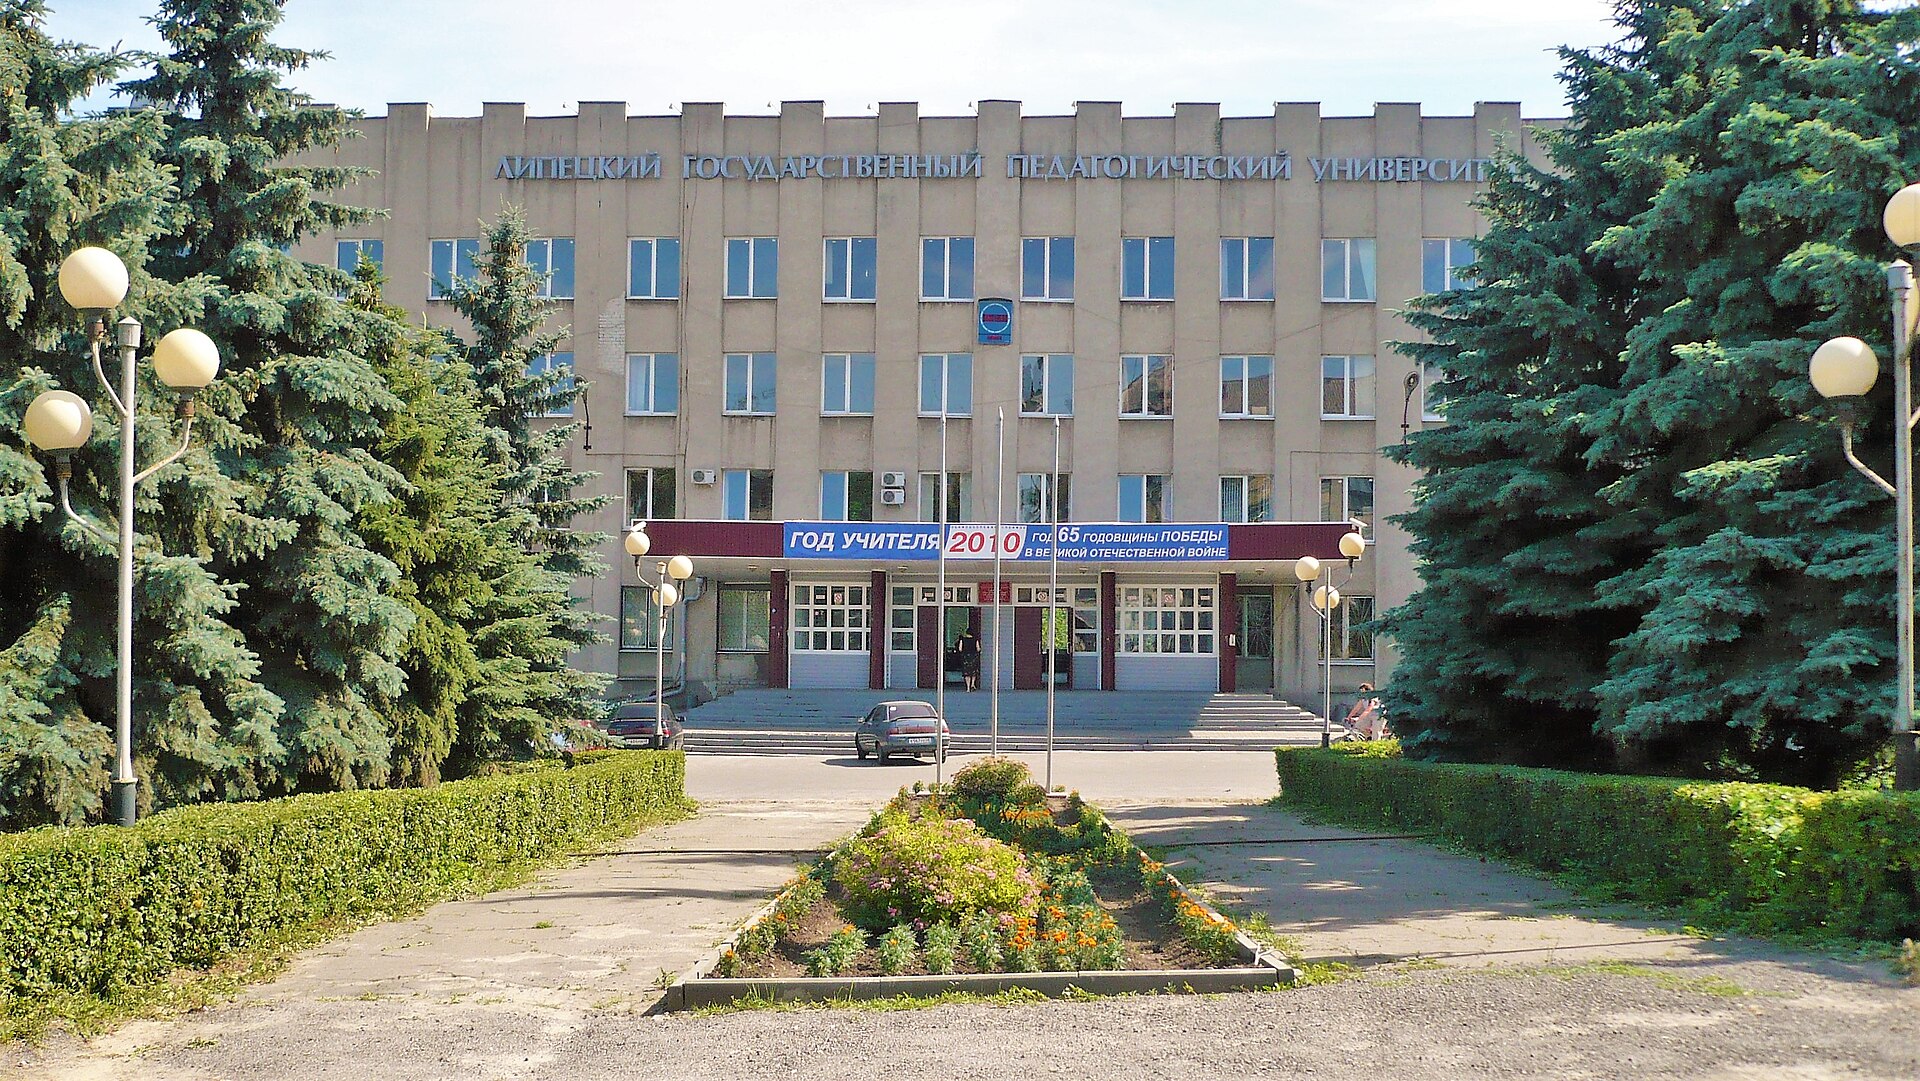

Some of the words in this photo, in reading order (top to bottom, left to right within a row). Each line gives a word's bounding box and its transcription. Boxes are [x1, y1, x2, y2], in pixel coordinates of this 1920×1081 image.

[495, 149, 662, 181] ЛИПЕЦКИЙ
[682, 148, 983, 182] ГОСУДАРСТВЕННЫЙ
[1007, 149, 1292, 182] ПЕДАГОГИЧЕСКИЙ
[1306, 156, 1516, 183] УНИВЕРСИТ
[790, 531, 835, 551] ГОД
[842, 532, 941, 550] УЧИТЕЛЯ
[949, 532, 1021, 553] 2010
[1058, 526, 1080, 542] 65
[1083, 532, 1158, 544] ГОДОВЩИНЫ
[1161, 530, 1223, 544] ПОБЕДЫ
[1025, 548, 1033, 557] В
[1035, 546, 1088, 558] ВЕИКОЙ
[1089, 546, 1185, 558] ОТЕЧЕСТВЕННОЙ
[1187, 545, 1227, 557] ВОЙНЕ
